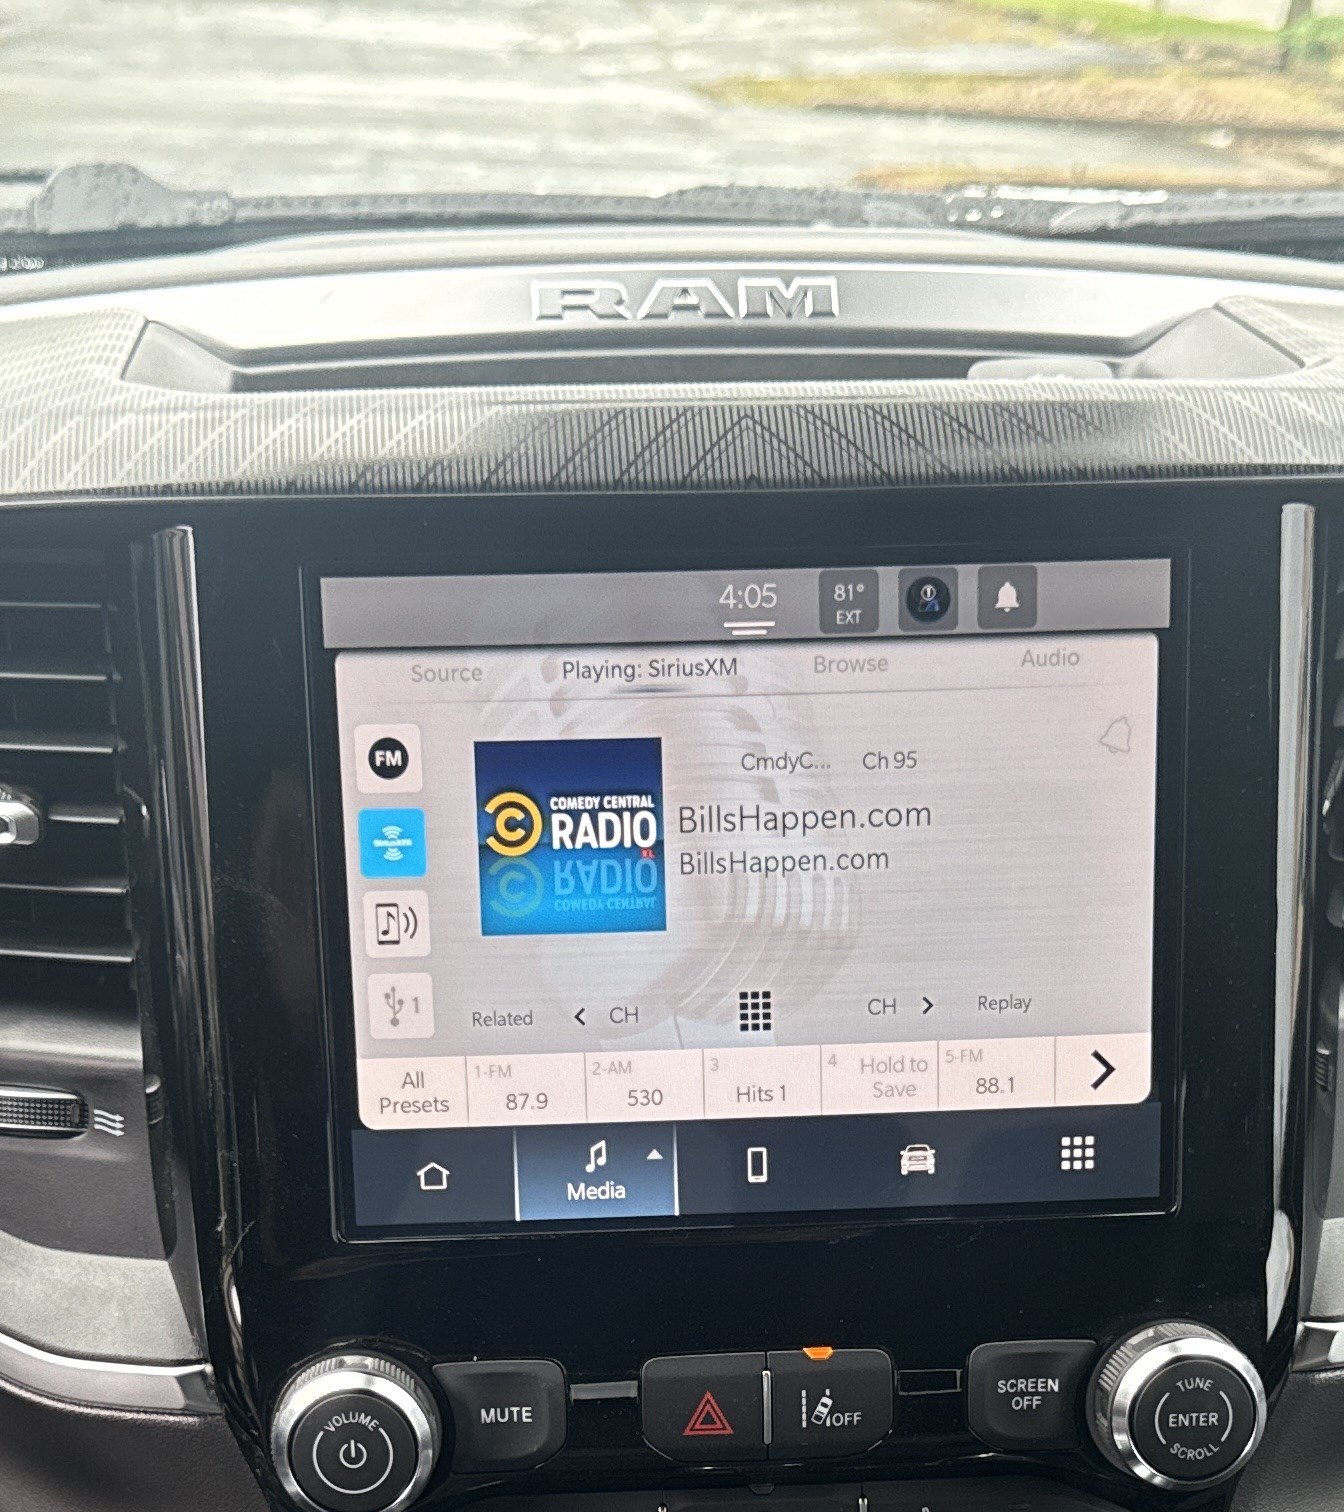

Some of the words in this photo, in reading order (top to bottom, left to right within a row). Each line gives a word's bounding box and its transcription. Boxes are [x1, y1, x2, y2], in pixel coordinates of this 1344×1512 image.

[530, 277, 840, 320] RAM
[719, 583, 778, 609] 4:05
[836, 610, 861, 624] EXT
[813, 655, 889, 673] Browse
[1021, 648, 1080, 667] Audio
[411, 664, 483, 682] Source
[562, 661, 642, 683] Playing:
[648, 658, 738, 678] SiriusXM
[375, 751, 402, 767] FM
[862, 752, 889, 770] Ch
[893, 751, 917, 769] 95
[550, 796, 600, 810] COMEDY
[603, 795, 655, 808] CENTRAL
[679, 804, 932, 837] BillsHappen.com
[552, 810, 657, 850] RADIO
[680, 851, 889, 878] BillsHappen.com
[413, 996, 420, 1013] 1
[867, 998, 897, 1016] CH
[977, 994, 1032, 1013] Replay
[471, 1009, 534, 1027] Related
[609, 1006, 639, 1024] CH
[710, 1058, 719, 1072] 3
[827, 1054, 837, 1068] 4
[860, 1055, 905, 1075] Hold
[910, 1055, 929, 1072] to
[945, 1049, 983, 1063] 5-FM
[474, 1064, 513, 1079] 1-FM
[592, 1060, 632, 1076] 2-AM
[401, 1070, 425, 1089] All
[975, 1076, 1015, 1094] 88.1
[627, 1088, 664, 1107] 530
[736, 1085, 773, 1103] Hits
[779, 1085, 786, 1101] 1
[872, 1080, 916, 1098] Save
[379, 1096, 450, 1114] Presets
[505, 1092, 549, 1111] 87.9
[567, 1182, 626, 1201] Media
[997, 1379, 1059, 1394] SCREEN
[1177, 1378, 1214, 1393] TUNE
[1011, 1397, 1042, 1411] OFF
[323, 1411, 380, 1433] VOLUME
[481, 1407, 533, 1424] MUTE
[833, 1412, 862, 1427] OFF
[1168, 1412, 1219, 1428] ENTER
[1169, 1442, 1220, 1461] SCROLL
